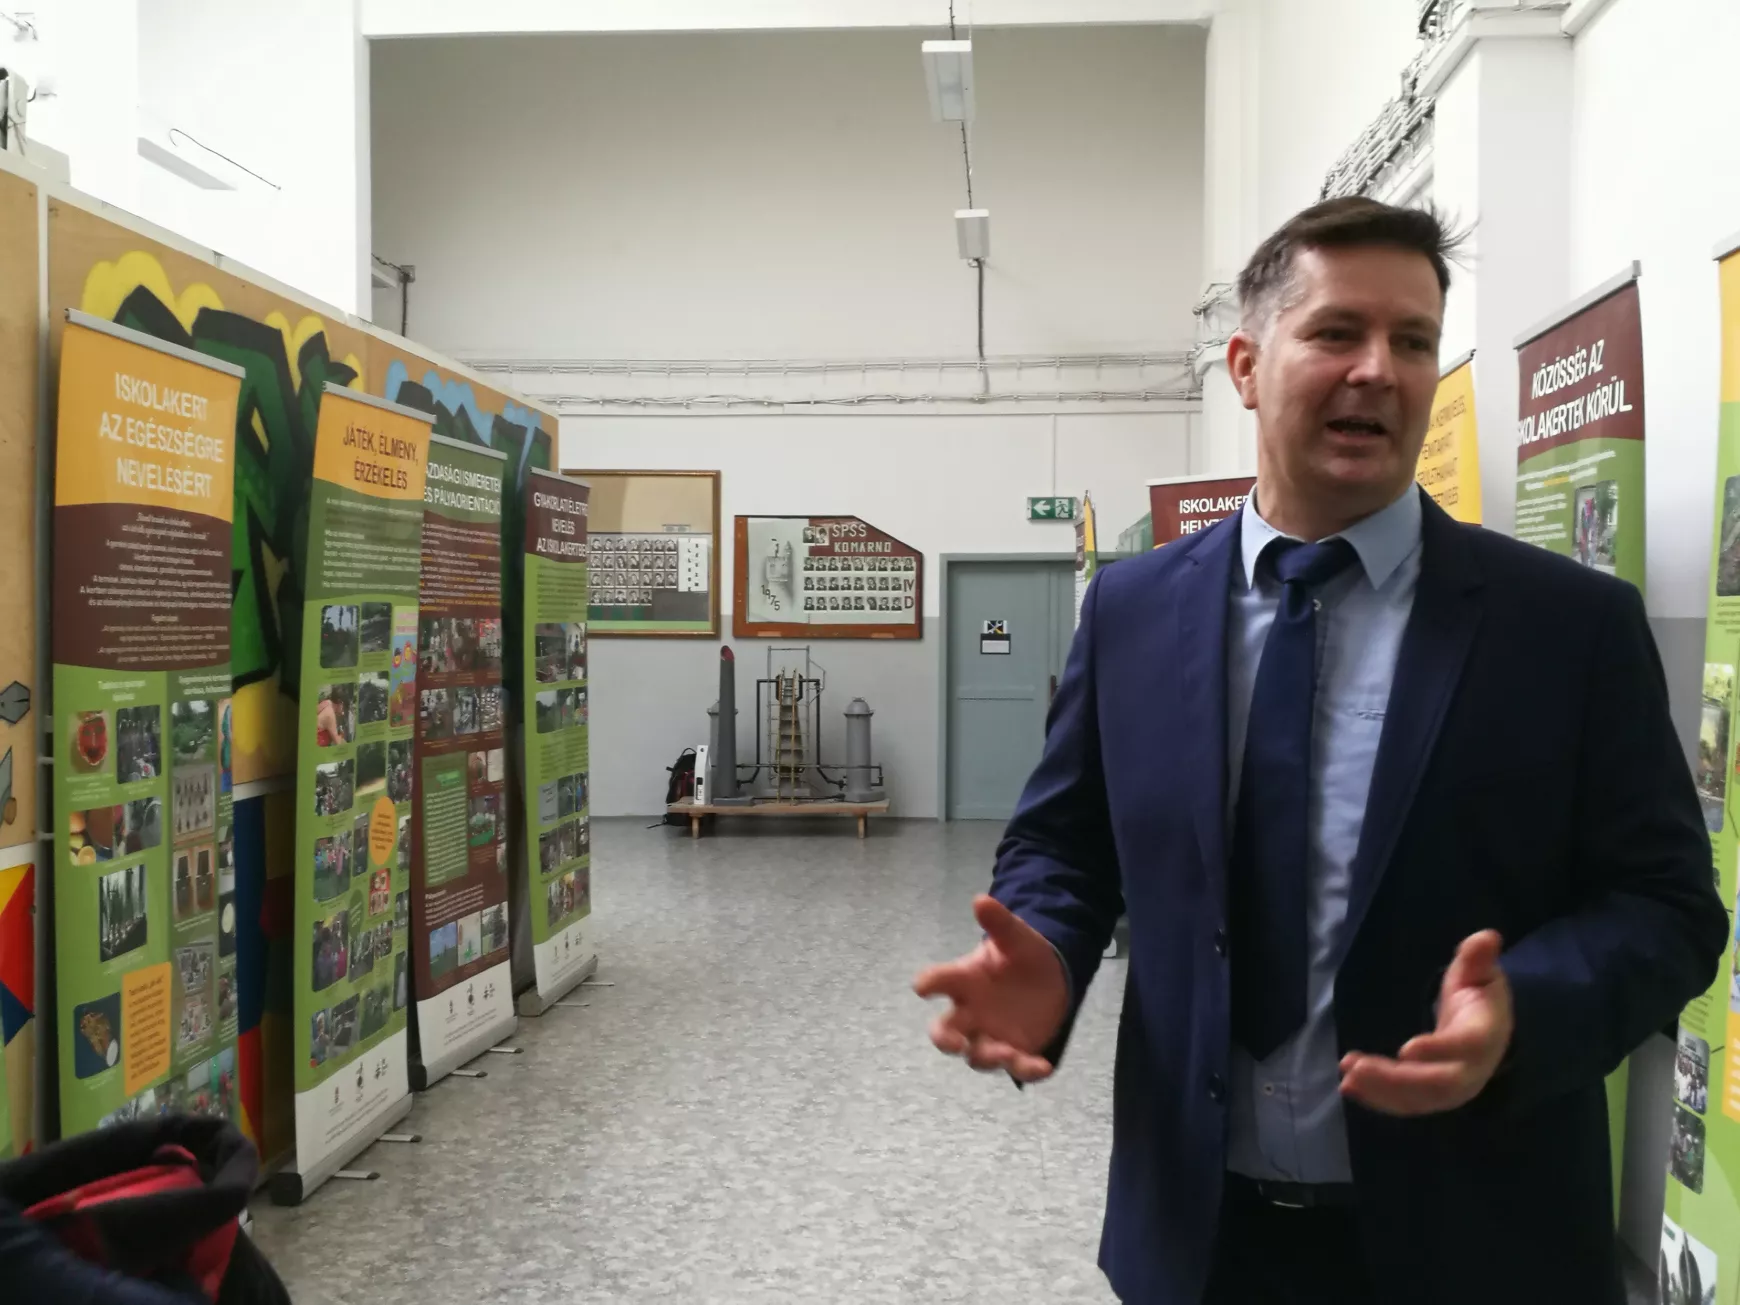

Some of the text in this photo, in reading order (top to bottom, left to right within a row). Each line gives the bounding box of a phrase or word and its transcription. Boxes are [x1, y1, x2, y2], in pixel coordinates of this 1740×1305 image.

[1531, 339, 1604, 400] KÖZÖSSÉG AZ
[115, 371, 208, 420] ISKOLAKERT
[1516, 375, 1633, 446] KOLAKERTEK KÖRÜL
[99, 411, 225, 462] AZ EGÉSZSÉGRE
[117, 456, 213, 498] NEVELÉSÉRT
[536, 537, 547, 552] AZ
[832, 524, 867, 537] SPSS
[760, 584, 781, 611] 1975
